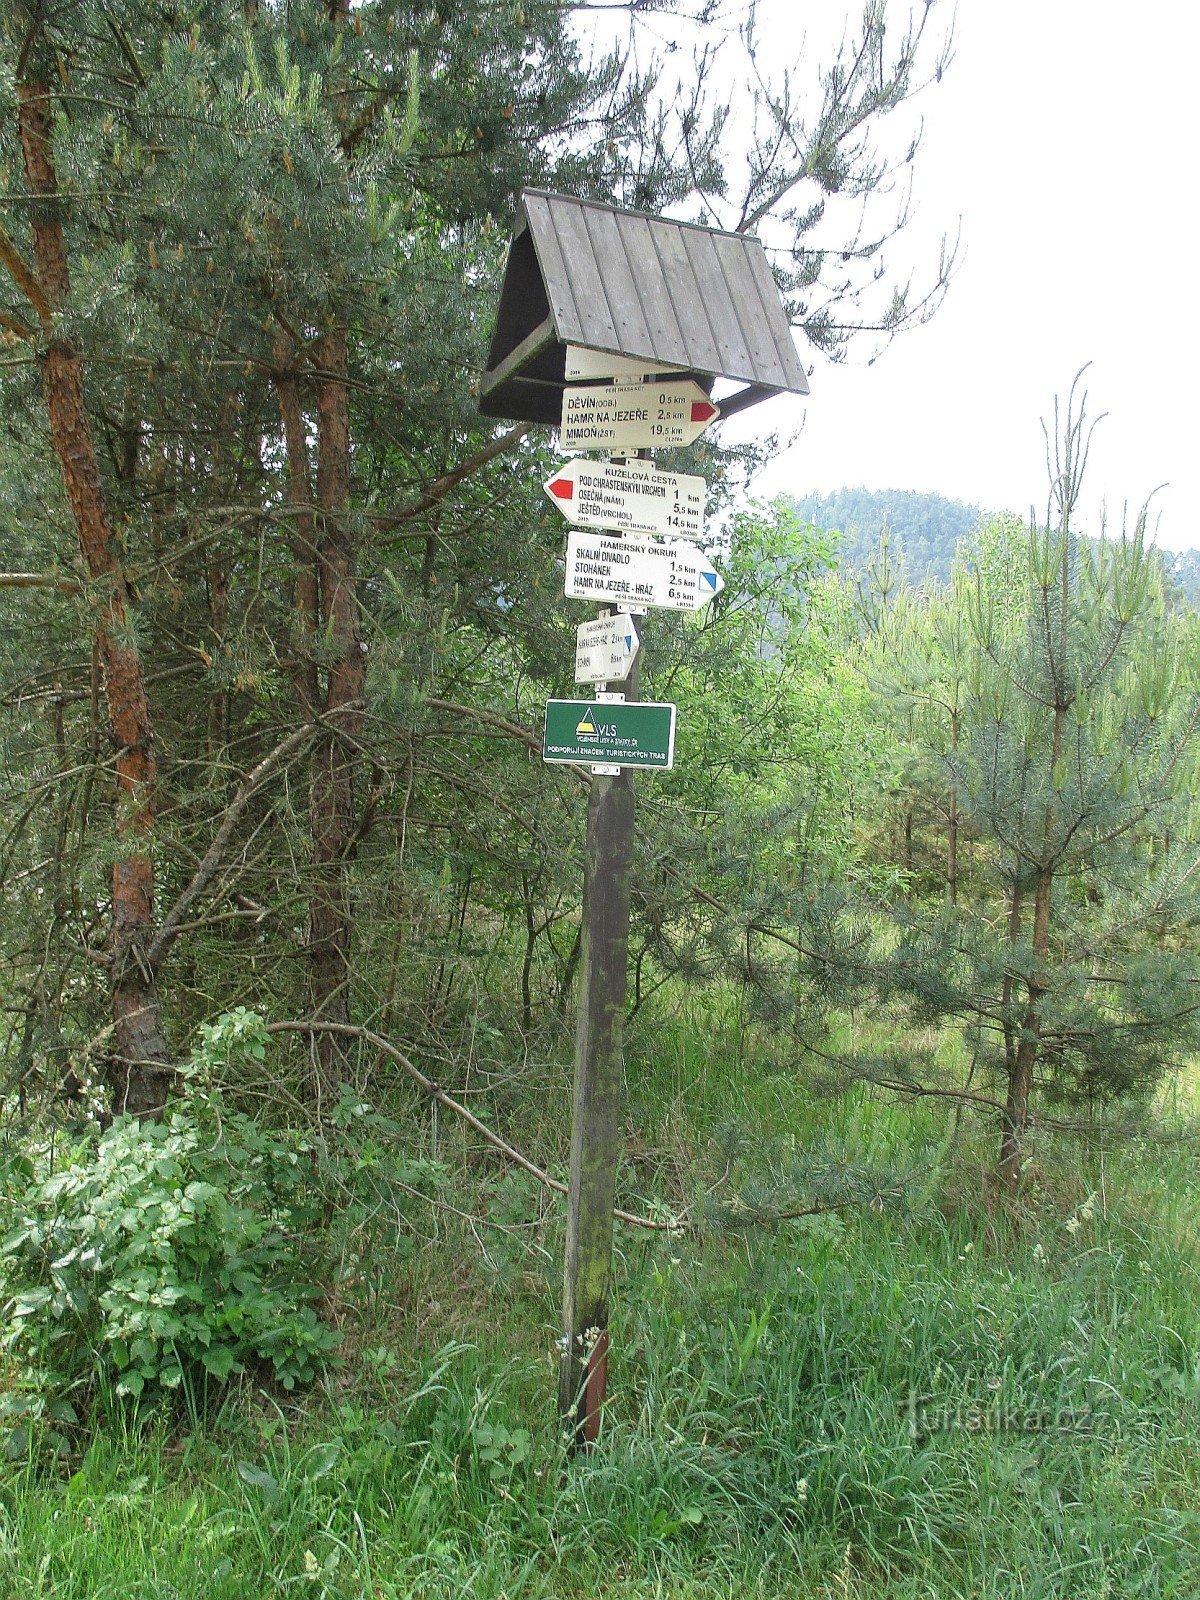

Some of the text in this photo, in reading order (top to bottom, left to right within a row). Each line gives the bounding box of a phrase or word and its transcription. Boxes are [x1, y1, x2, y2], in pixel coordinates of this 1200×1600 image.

[568, 396, 596, 409] DĚVÍN
[660, 394, 672, 405] 0,5
[567, 408, 684, 424] HAMR NA JEZEŘE 2,5 km
[566, 425, 597, 438] MIMOŇ
[651, 424, 669, 436] 19,5
[605, 468, 677, 486] KUŽELOVÁ CESTA
[580, 476, 700, 502] POD CHRASTENSKÝM VRCHEM 1 km
[578, 488, 603, 503] OSEČNÁ
[674, 503, 686, 514] 5,5
[688, 508, 698, 516] km
[578, 502, 698, 529] JEŠTĚD (VRCHOL) 14,5 km
[600, 540, 676, 558] HAMERSKÝ OKRUH
[576, 548, 696, 574] SKALNÍ DIVADLO 1,5 km
[575, 562, 696, 587] STOHÁNEK 2,5 km
[574, 576, 594, 588] HAMR
[594, 579, 604, 590] NA
[605, 580, 630, 592] JEZEŘE
[636, 582, 654, 596] HRÁZ
[668, 588, 680, 600] 6,5
[682, 592, 694, 600] km
[598, 724, 617, 737] VLS
[548, 746, 580, 755] PODPORUJÍ
[606, 749, 648, 758] TURISTICKÝCH
[650, 752, 666, 760] TRAS
